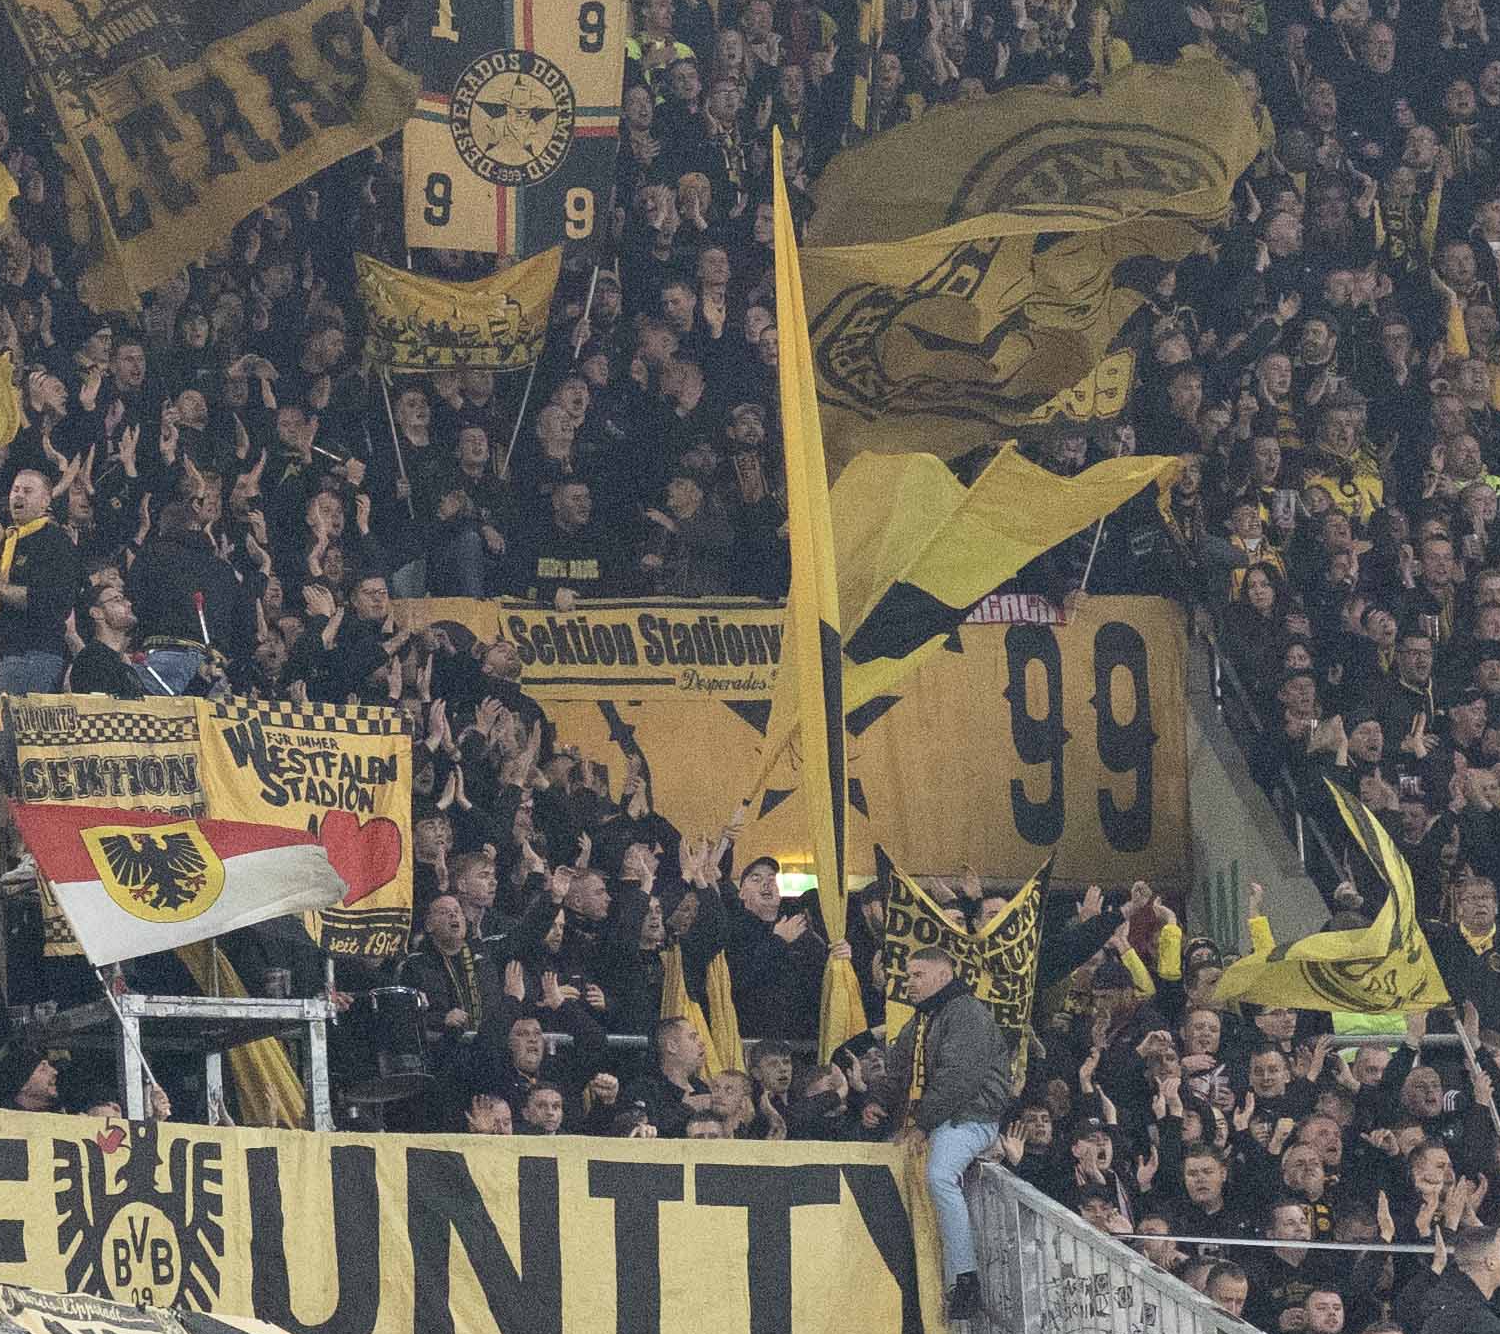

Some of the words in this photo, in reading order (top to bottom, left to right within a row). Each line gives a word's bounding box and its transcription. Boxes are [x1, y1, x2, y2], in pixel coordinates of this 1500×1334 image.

[578, 1, 605, 53] 9
[424, 172, 452, 226] 9
[565, 187, 594, 239] 9
[509, 614, 638, 667] Sektion
[1005, 621, 1155, 853] 99
[112, 1216, 174, 1284] BVB
